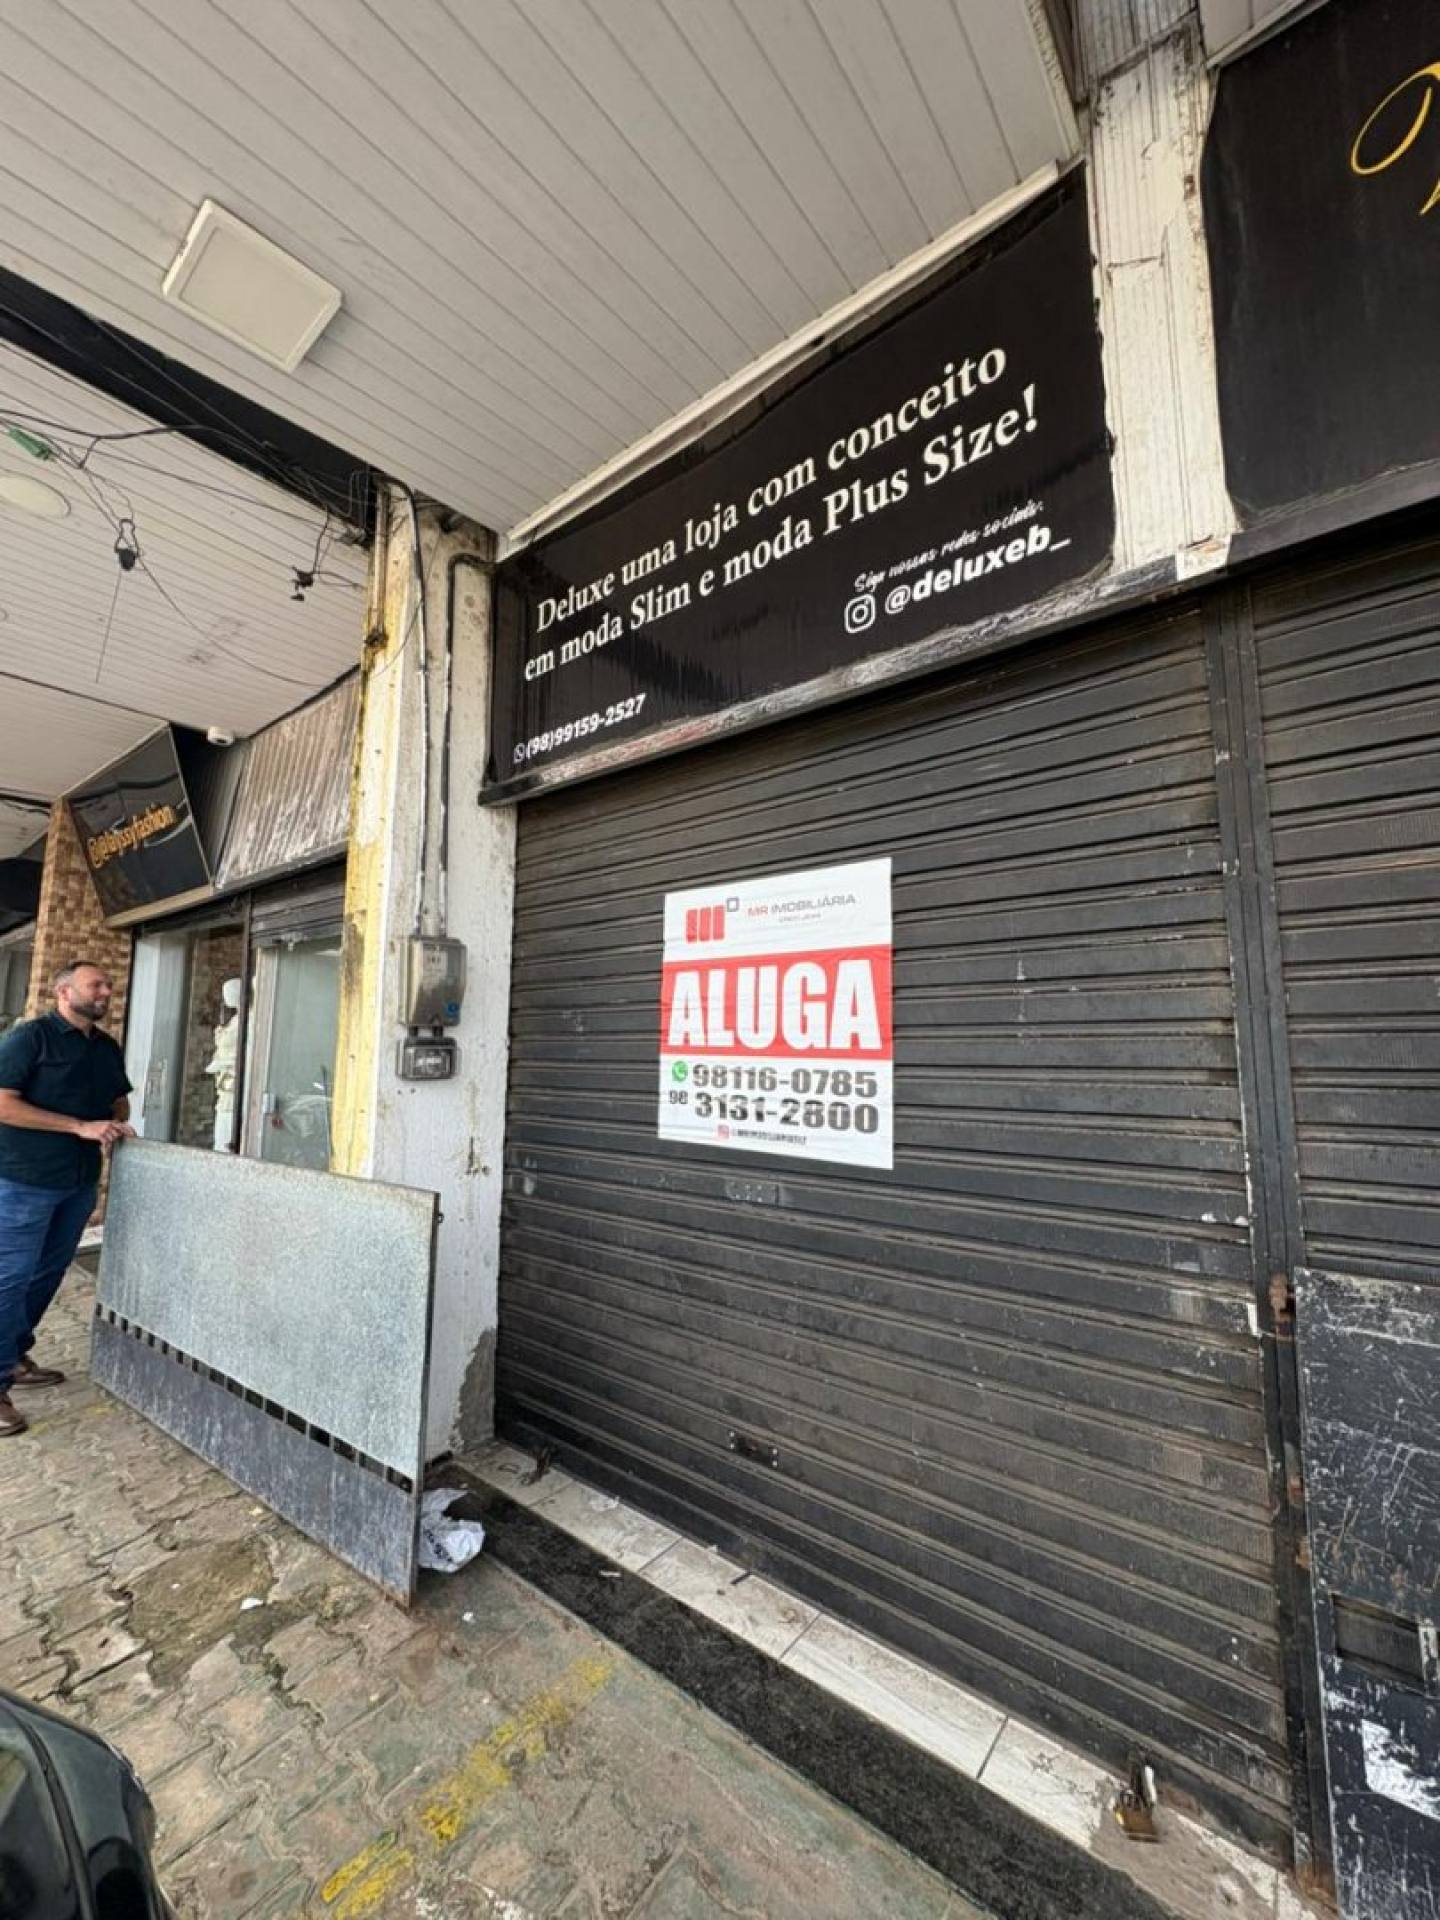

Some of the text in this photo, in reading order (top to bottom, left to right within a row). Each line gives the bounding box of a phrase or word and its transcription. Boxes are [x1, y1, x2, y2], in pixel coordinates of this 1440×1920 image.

[525, 384, 1037, 681] em moda Slim e moda Plus Size!
[537, 349, 1005, 632] Deluxe uma loja com conceito
[885, 524, 1070, 614] @deluxeb_
[771, 893, 856, 914] IMOBILIÁRIA
[668, 959, 882, 1050] ALUGA
[693, 1063, 877, 1098] 98116-0785
[694, 1092, 879, 1135] 3131-2800
